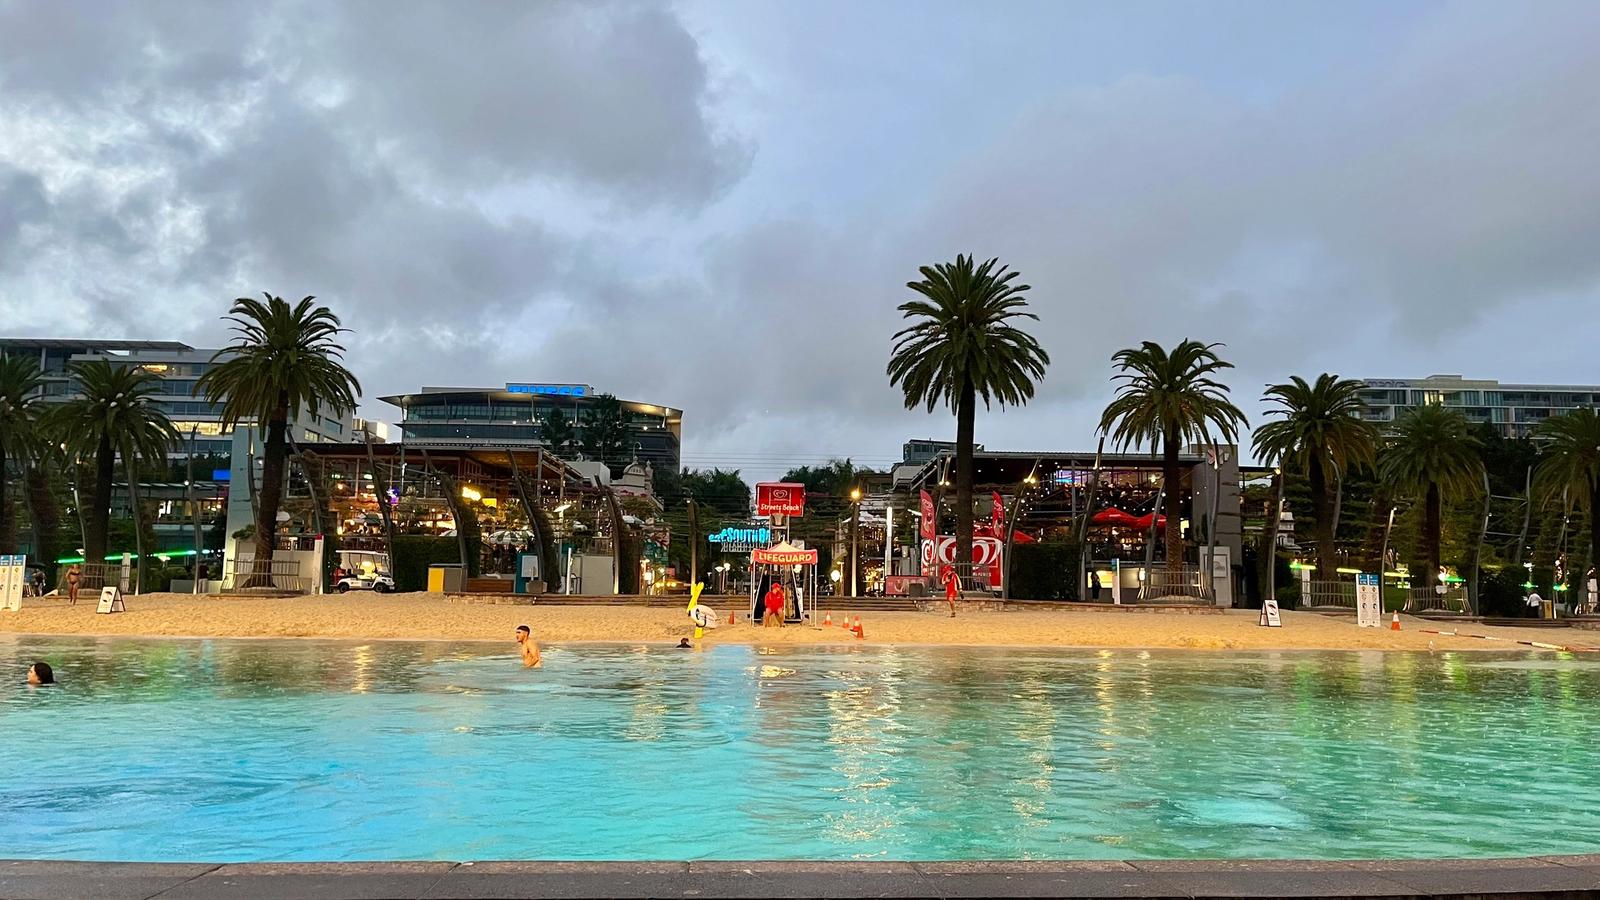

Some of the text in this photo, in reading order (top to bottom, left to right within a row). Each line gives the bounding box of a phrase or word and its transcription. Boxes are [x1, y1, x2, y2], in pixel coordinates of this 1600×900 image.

[760, 503, 800, 511] Streets Beach
[759, 551, 812, 563] LIFEGUARD
